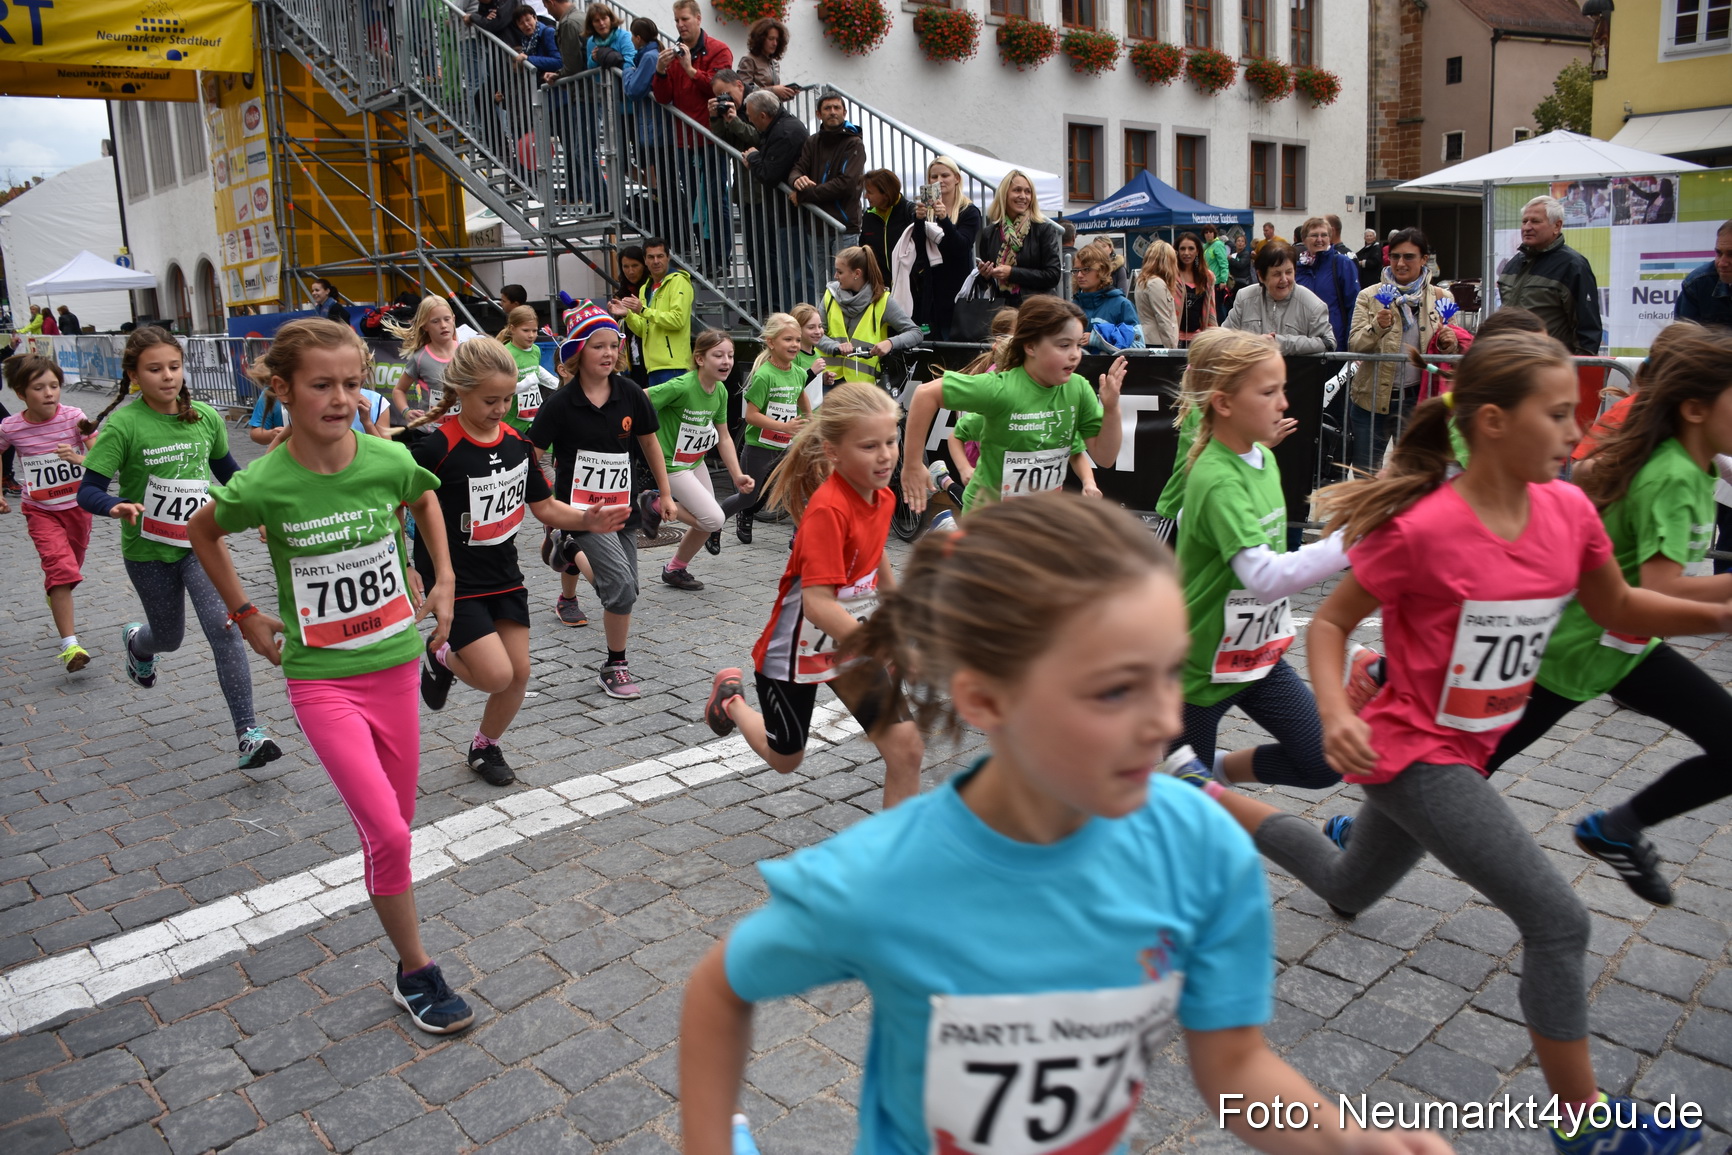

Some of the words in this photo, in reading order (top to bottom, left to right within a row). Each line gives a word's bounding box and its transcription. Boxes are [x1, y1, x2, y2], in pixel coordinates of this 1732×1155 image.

[96, 30, 165, 44] Neumarkter
[169, 34, 222, 47] Stadtlauf
[57, 69, 122, 79] Neumarkter
[123, 70, 170, 80] Stadtlauf
[1109, 217, 1140, 228] Tagblatt
[1192, 213, 1219, 223] Neumarkter
[1632, 286, 1679, 305] Neu
[1638, 311, 1675, 320] einkauf
[143, 442, 193, 457] Neumarkter
[684, 433, 716, 451] 7441
[144, 452, 185, 466] Stadtlauf
[578, 455, 600, 465] PARTL
[30, 463, 82, 487] 7066
[472, 483, 497, 493] PARTL
[498, 471, 523, 487] Neumarkt
[582, 465, 628, 490] 7178
[1012, 462, 1063, 493] 7071
[48, 487, 74, 498] Emma
[149, 480, 172, 493] PARTL
[480, 479, 525, 521] 7429
[282, 509, 364, 533] Neumarkter
[286, 525, 351, 547] Stadtlauf
[294, 565, 335, 578] PARTL
[336, 549, 387, 573] Neumarkt
[307, 560, 397, 618] 7085
[1228, 597, 1262, 606] PARTL
[343, 616, 382, 637] Lucia
[1464, 614, 1513, 627] PARTL
[938, 1021, 1044, 1048] PARTL
